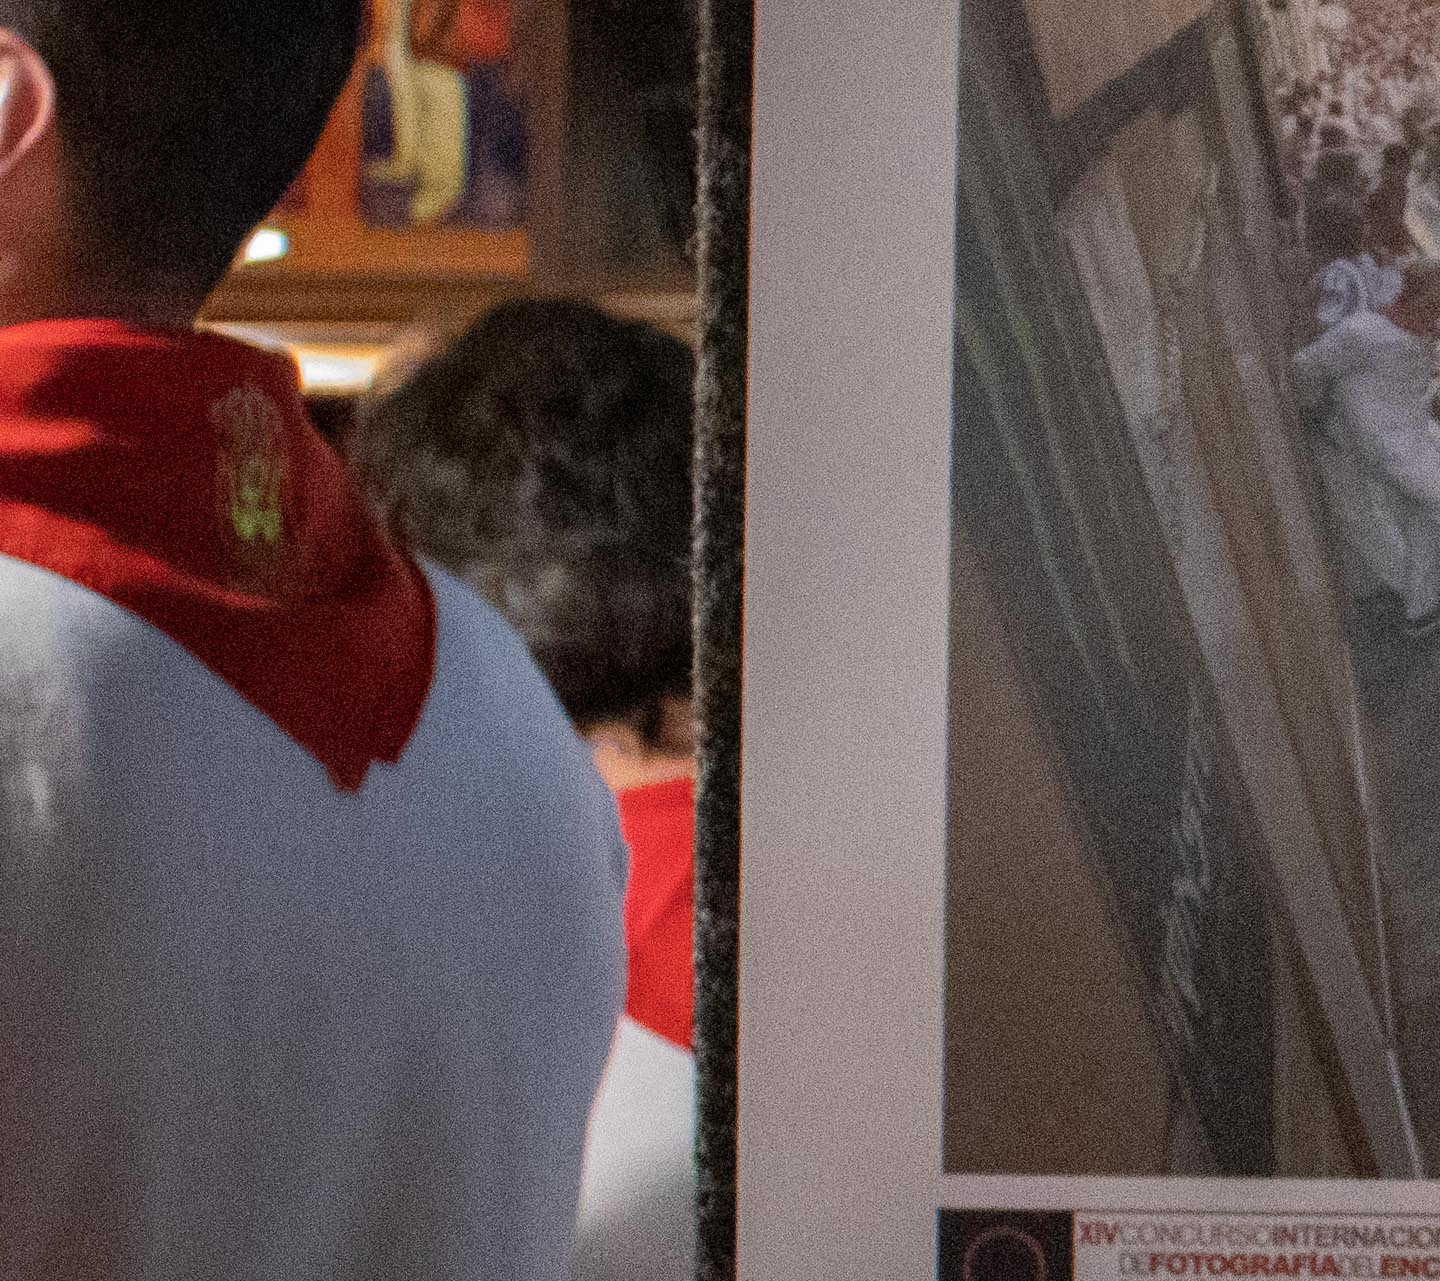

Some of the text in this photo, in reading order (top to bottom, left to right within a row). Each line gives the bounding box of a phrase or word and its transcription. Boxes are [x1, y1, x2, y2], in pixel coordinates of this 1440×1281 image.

[1079, 1222, 1118, 1245] XIV
[1120, 1224, 1270, 1246] CONCURSO
[1120, 1253, 1149, 1275] DE
[1150, 1251, 1340, 1276] FOTOGRAFÍA
[1341, 1255, 1378, 1278] DEL
